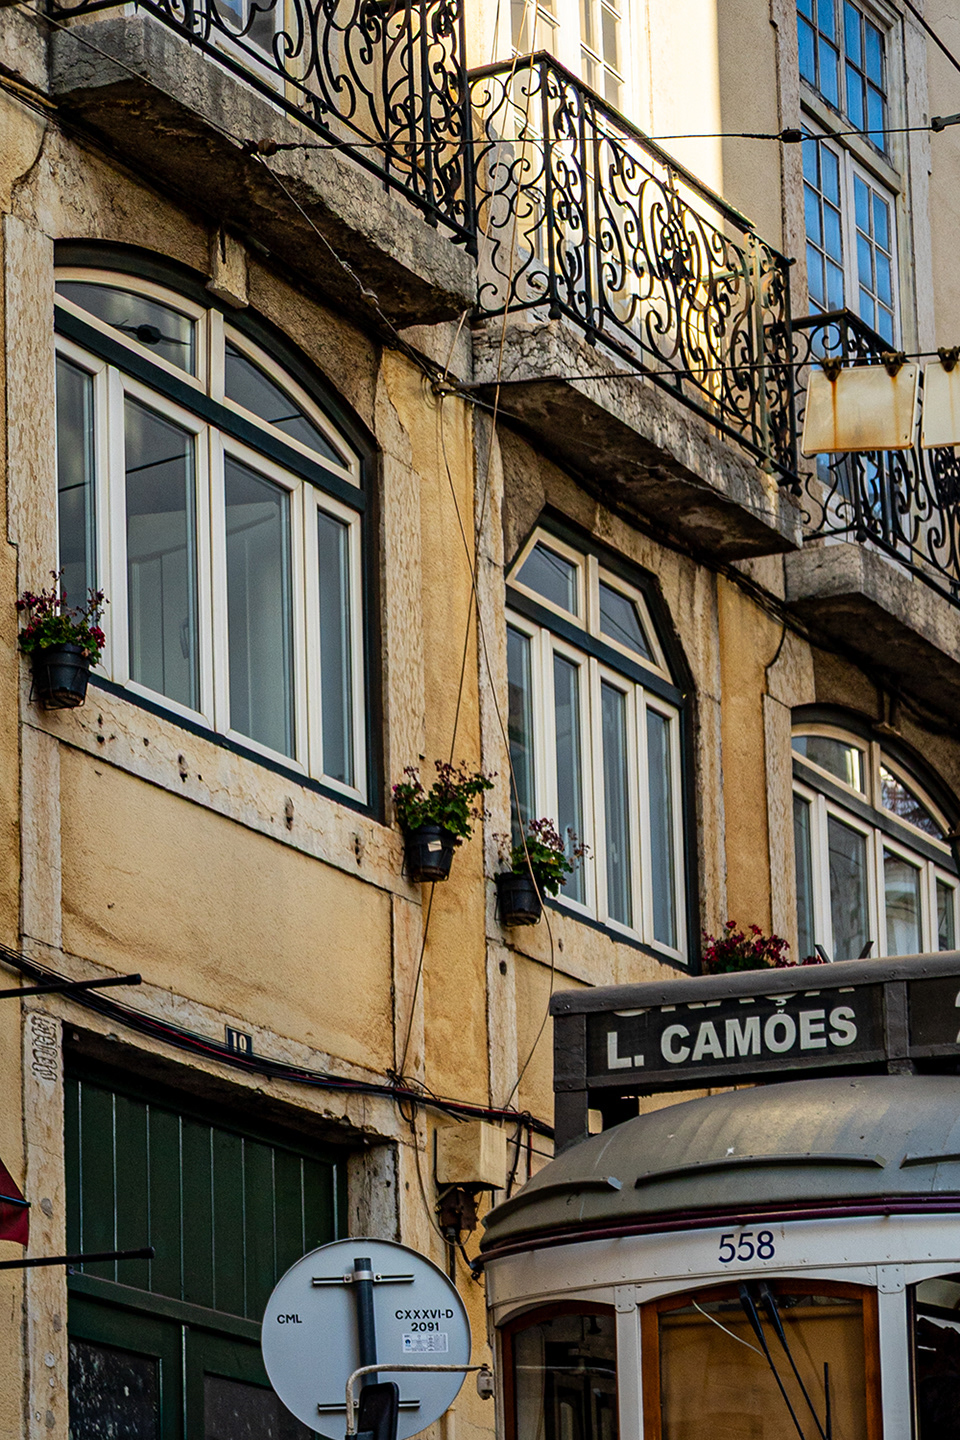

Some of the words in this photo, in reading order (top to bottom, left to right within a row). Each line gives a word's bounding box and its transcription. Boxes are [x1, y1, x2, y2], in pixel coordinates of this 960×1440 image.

[607, 1031, 644, 1070] L.
[660, 1006, 858, 1064] CAMÕES
[718, 1230, 775, 1263] 558
[276, 1313, 303, 1325] CML
[394, 1308, 454, 1320] CXXXVI-D
[411, 1322, 439, 1332] 2091
